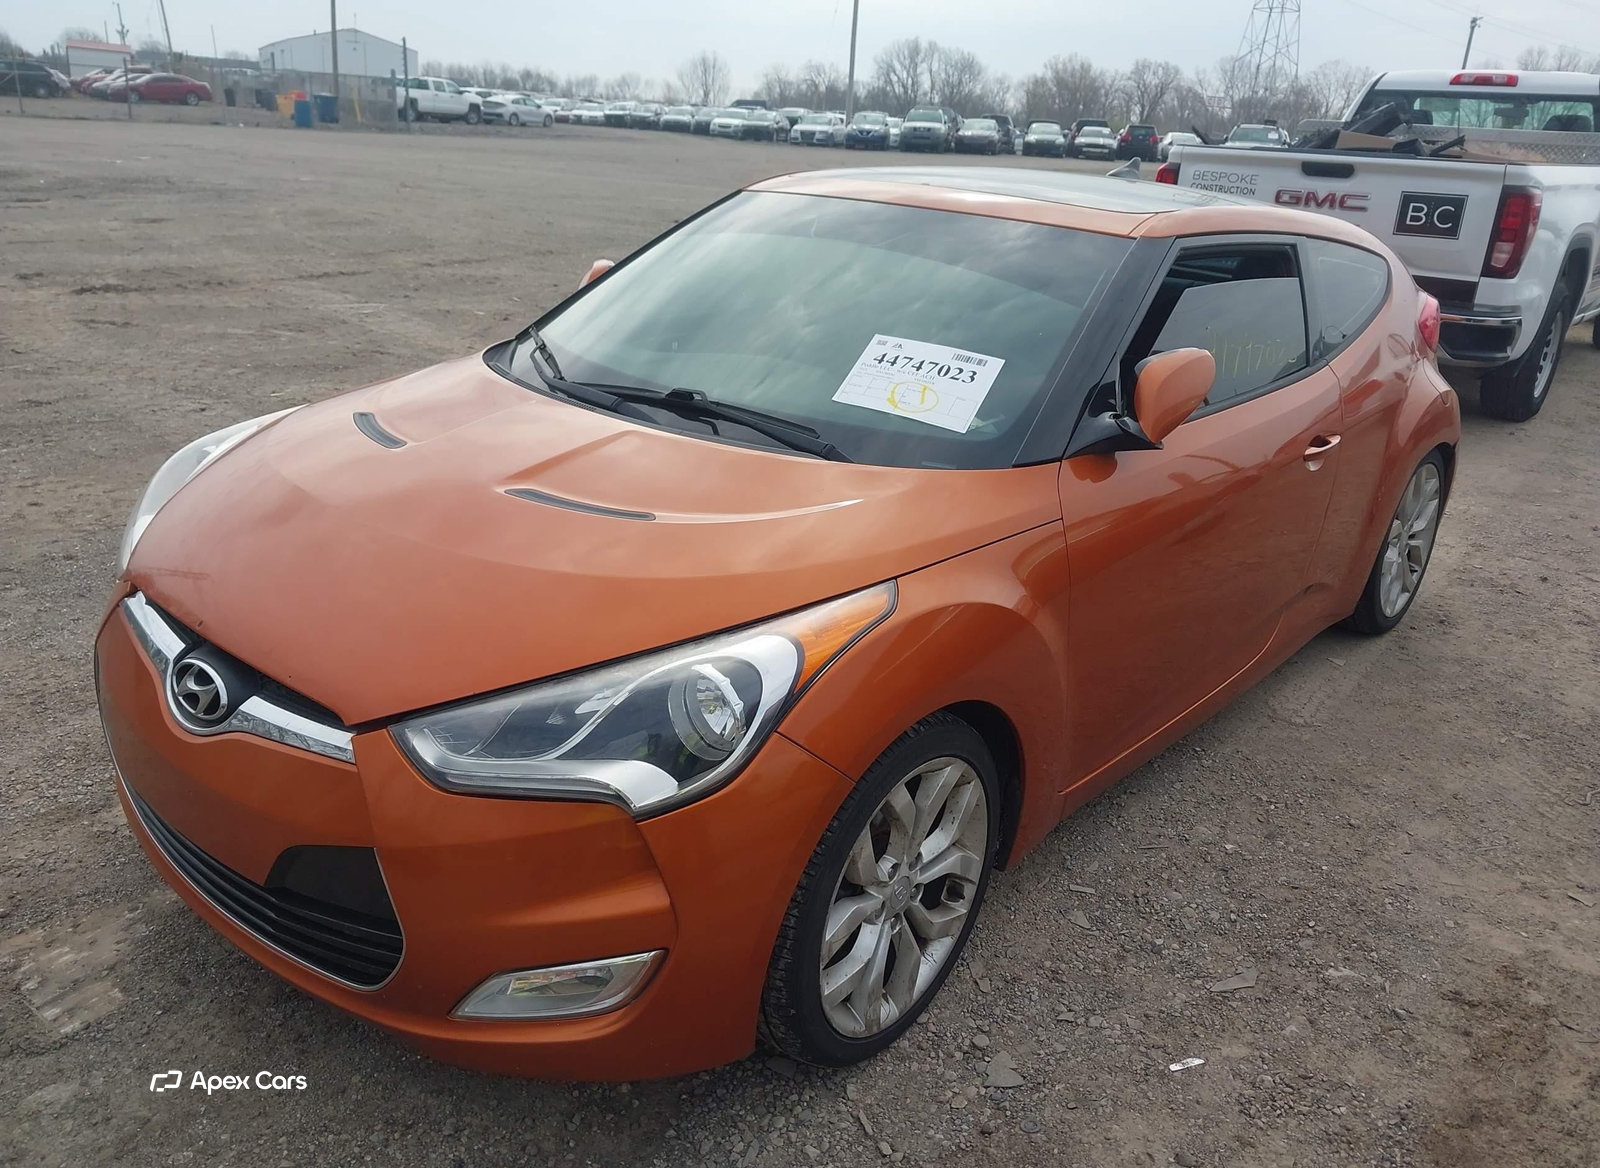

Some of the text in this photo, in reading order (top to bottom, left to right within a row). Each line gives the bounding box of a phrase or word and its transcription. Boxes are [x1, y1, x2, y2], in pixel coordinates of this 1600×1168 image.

[1192, 169, 1259, 185] BESPOKE
[1190, 182, 1256, 196] CONSTRUCTION
[1274, 188, 1370, 211] GMC
[873, 352, 978, 384] 44747023
